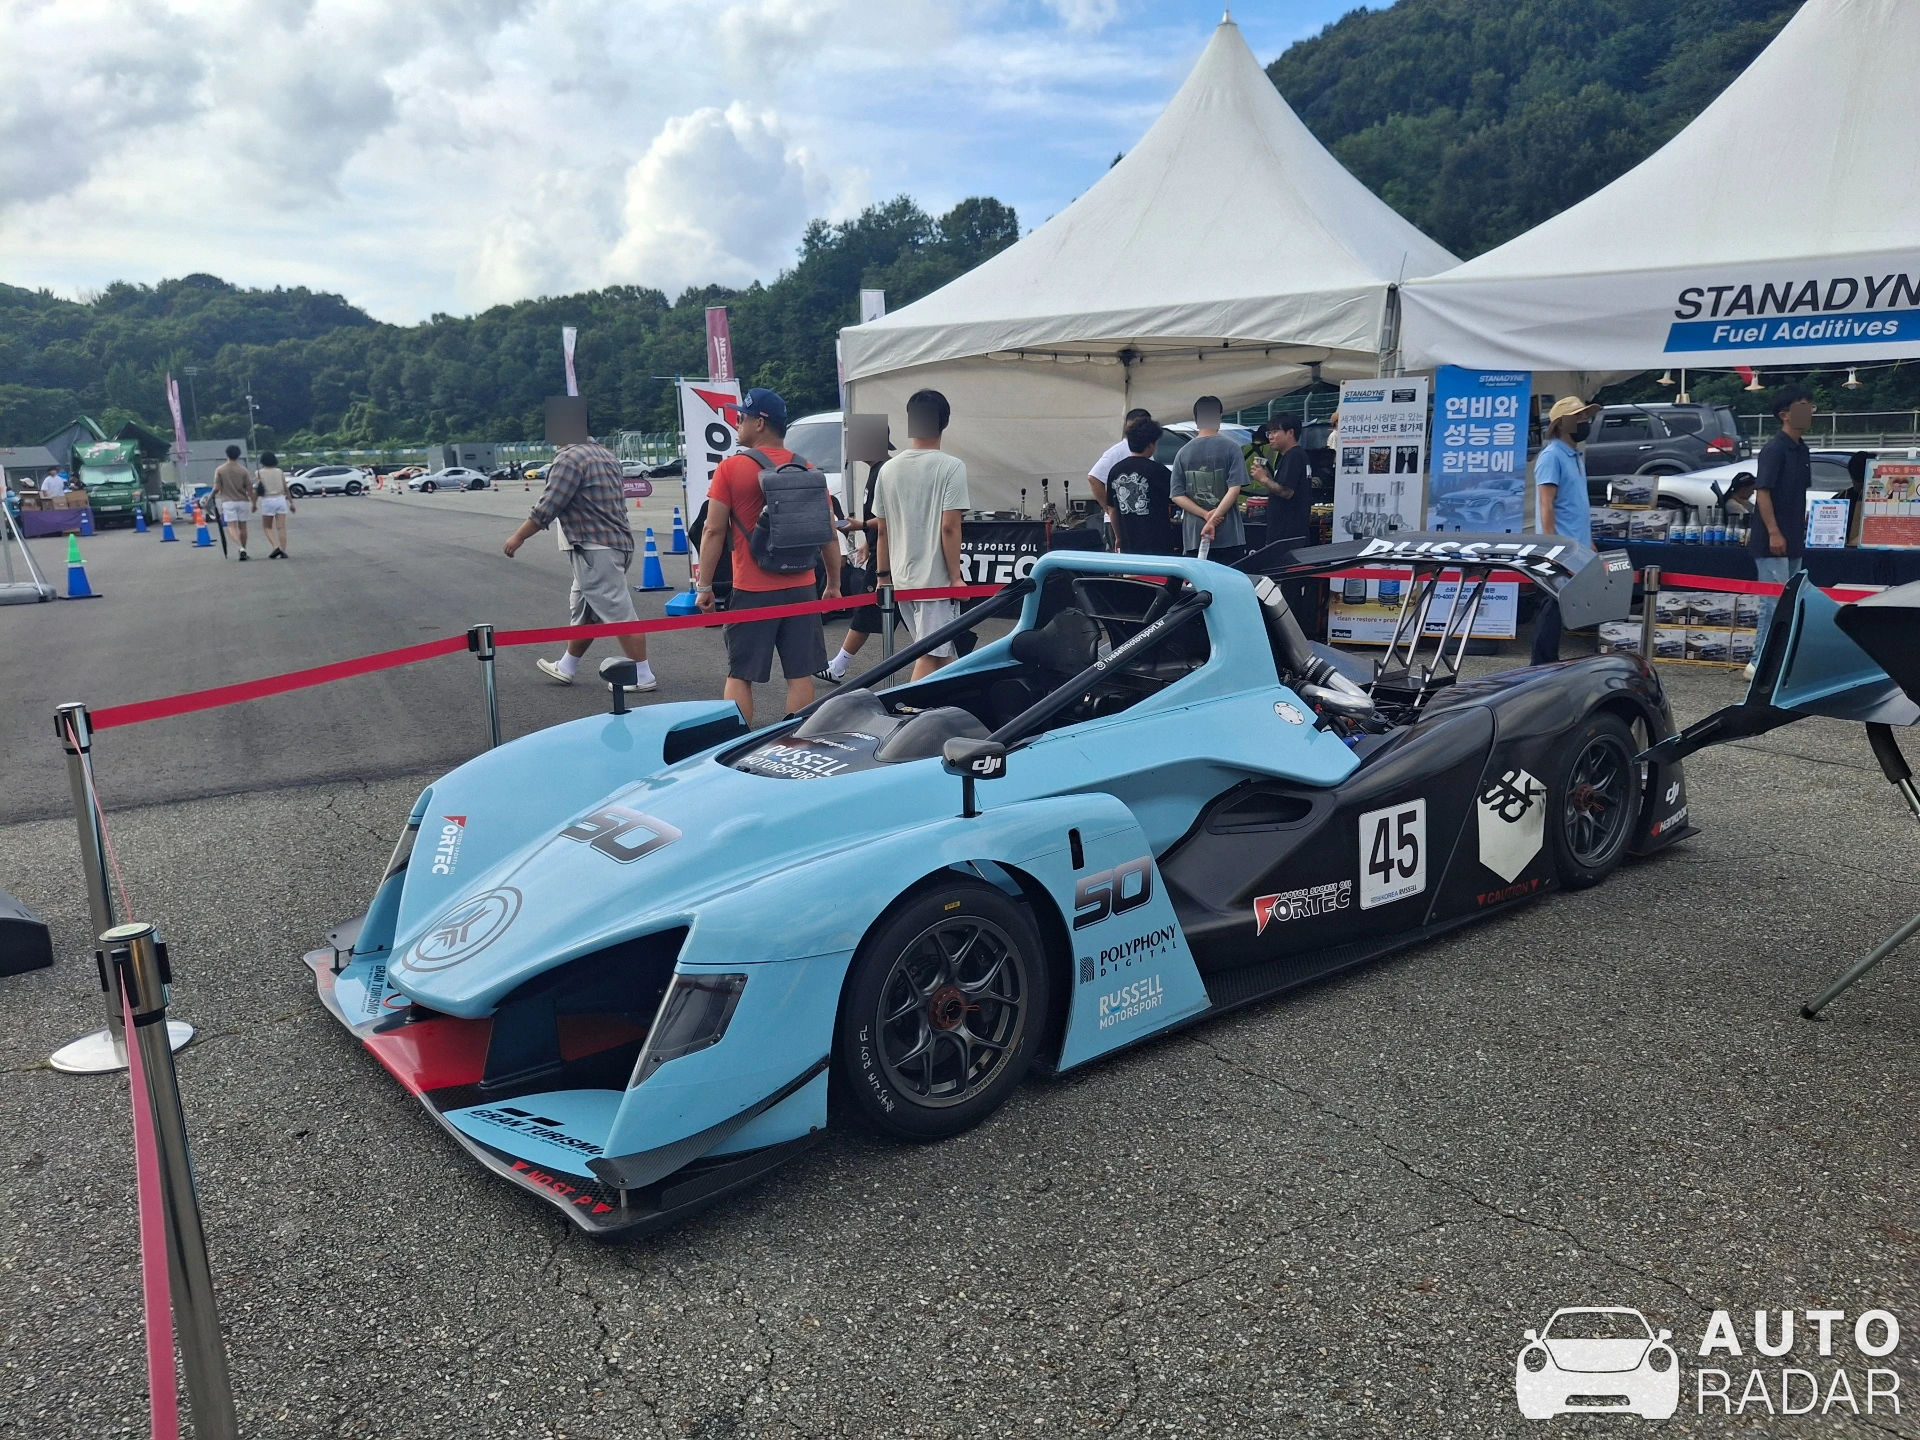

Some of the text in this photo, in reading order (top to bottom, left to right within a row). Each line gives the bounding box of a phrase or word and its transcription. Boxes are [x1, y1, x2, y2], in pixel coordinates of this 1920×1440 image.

[1674, 273, 1920, 320] STANADYN
[1712, 318, 1899, 344] Fuel Additives
[1344, 389, 1386, 398] STANADYNE
[1341, 412, 1424, 424] 세계에서 사랑받고 있는
[1445, 395, 1519, 419] 연비와
[1340, 422, 1424, 434] 스타나다인 연료 첨가제
[1443, 422, 1516, 447] 성능을
[1442, 450, 1515, 473] 한번에
[977, 543, 1016, 552] SPORTS
[1020, 543, 1037, 552] OIL
[960, 553, 1038, 583] RTEC
[757, 744, 849, 777] RUSSELL
[558, 804, 683, 865] 50
[1368, 809, 1419, 884] 45
[1073, 855, 1153, 931] 50
[1281, 879, 1352, 899] MOTOR SPORTS OIL
[1487, 883, 1529, 904] CAUTION
[1253, 887, 1351, 937] FORTEC
[1100, 923, 1176, 966] POLYPHONY
[1101, 941, 1177, 977] DIGITAL
[367, 965, 386, 1015] GRAN TURISMO
[1099, 974, 1163, 1017] RUSSELL
[1099, 994, 1164, 1030] MOTORSPORT
[859, 1024, 869, 1042] FL
[861, 1046, 873, 1070] ROY
[974, 1080, 988, 1091] RACE
[469, 1109, 528, 1127] GRAN
[522, 1170, 554, 1187] NO
